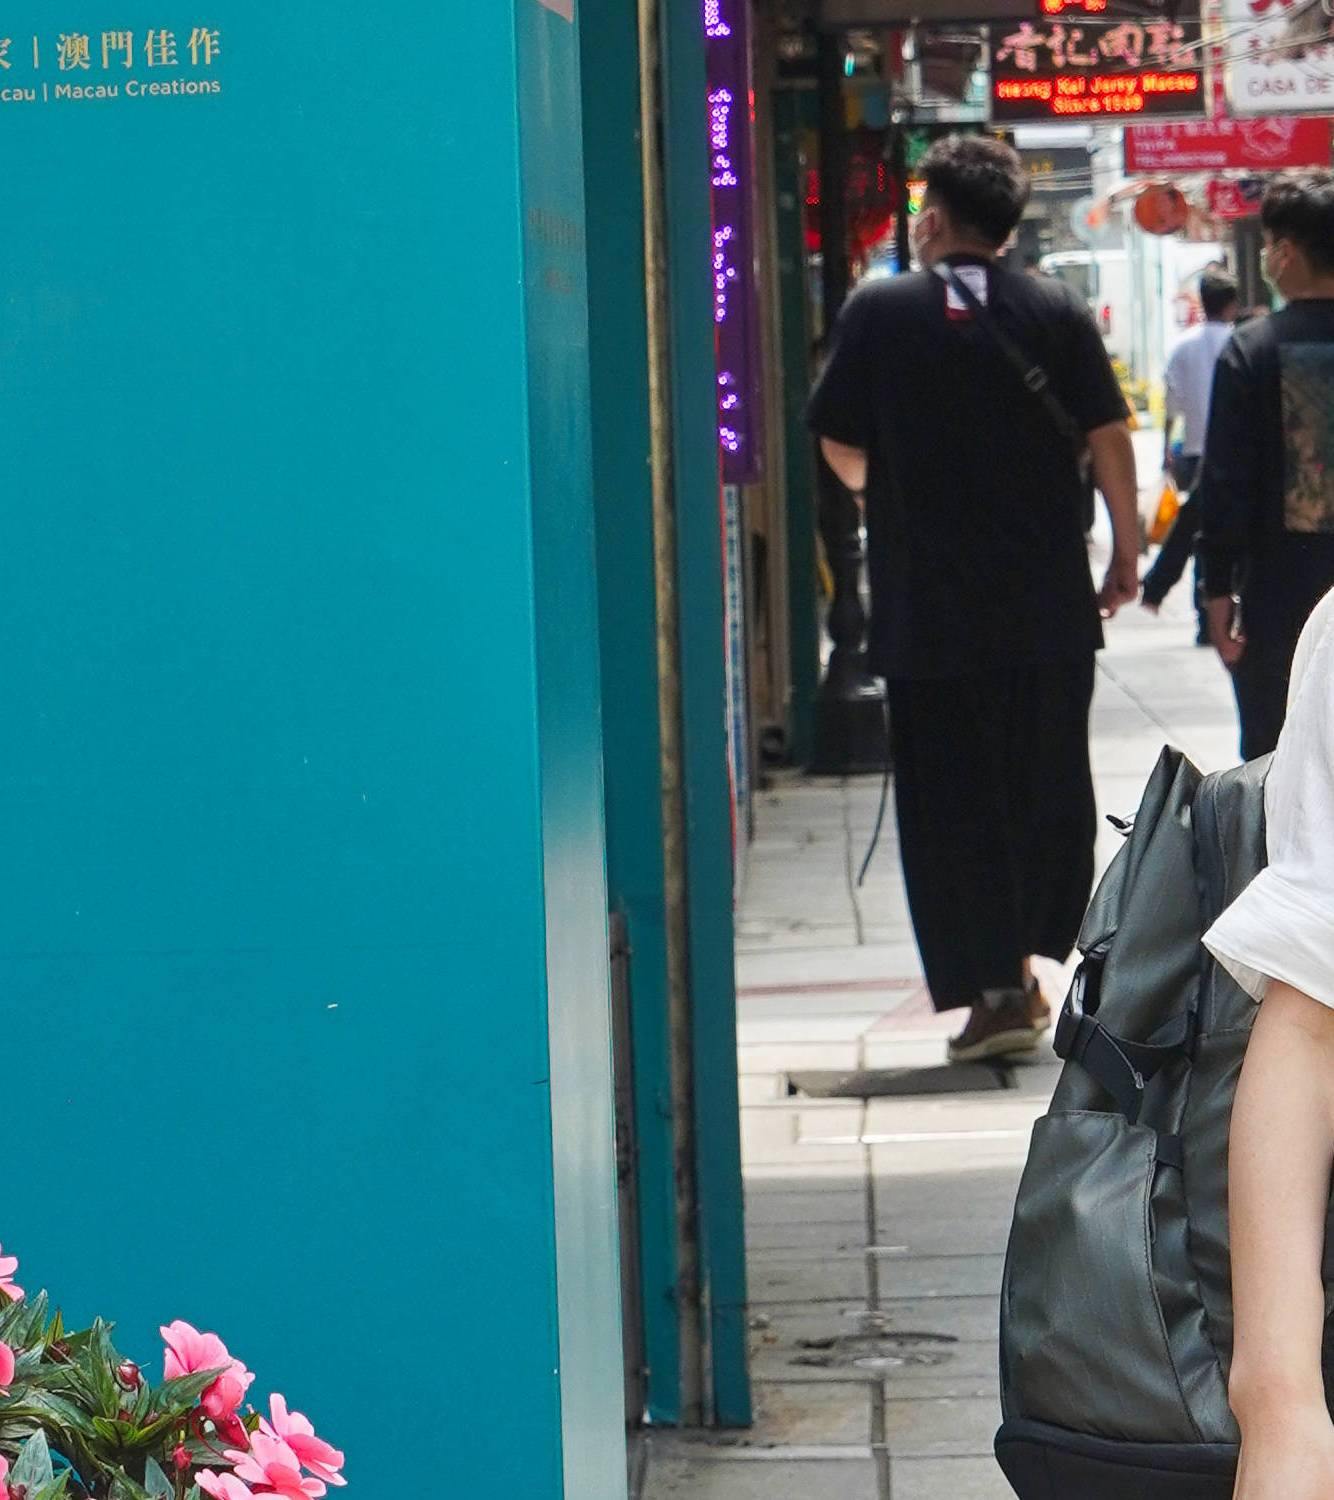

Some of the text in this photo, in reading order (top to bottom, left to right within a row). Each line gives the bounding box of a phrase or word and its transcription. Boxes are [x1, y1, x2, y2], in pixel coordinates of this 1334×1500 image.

[56, 27, 222, 71] 澳門佳作
[54, 82, 119, 99] Macau
[125, 77, 221, 97] Creations
[1248, 78, 1297, 97] CASA
[1306, 77, 1331, 94] DE
